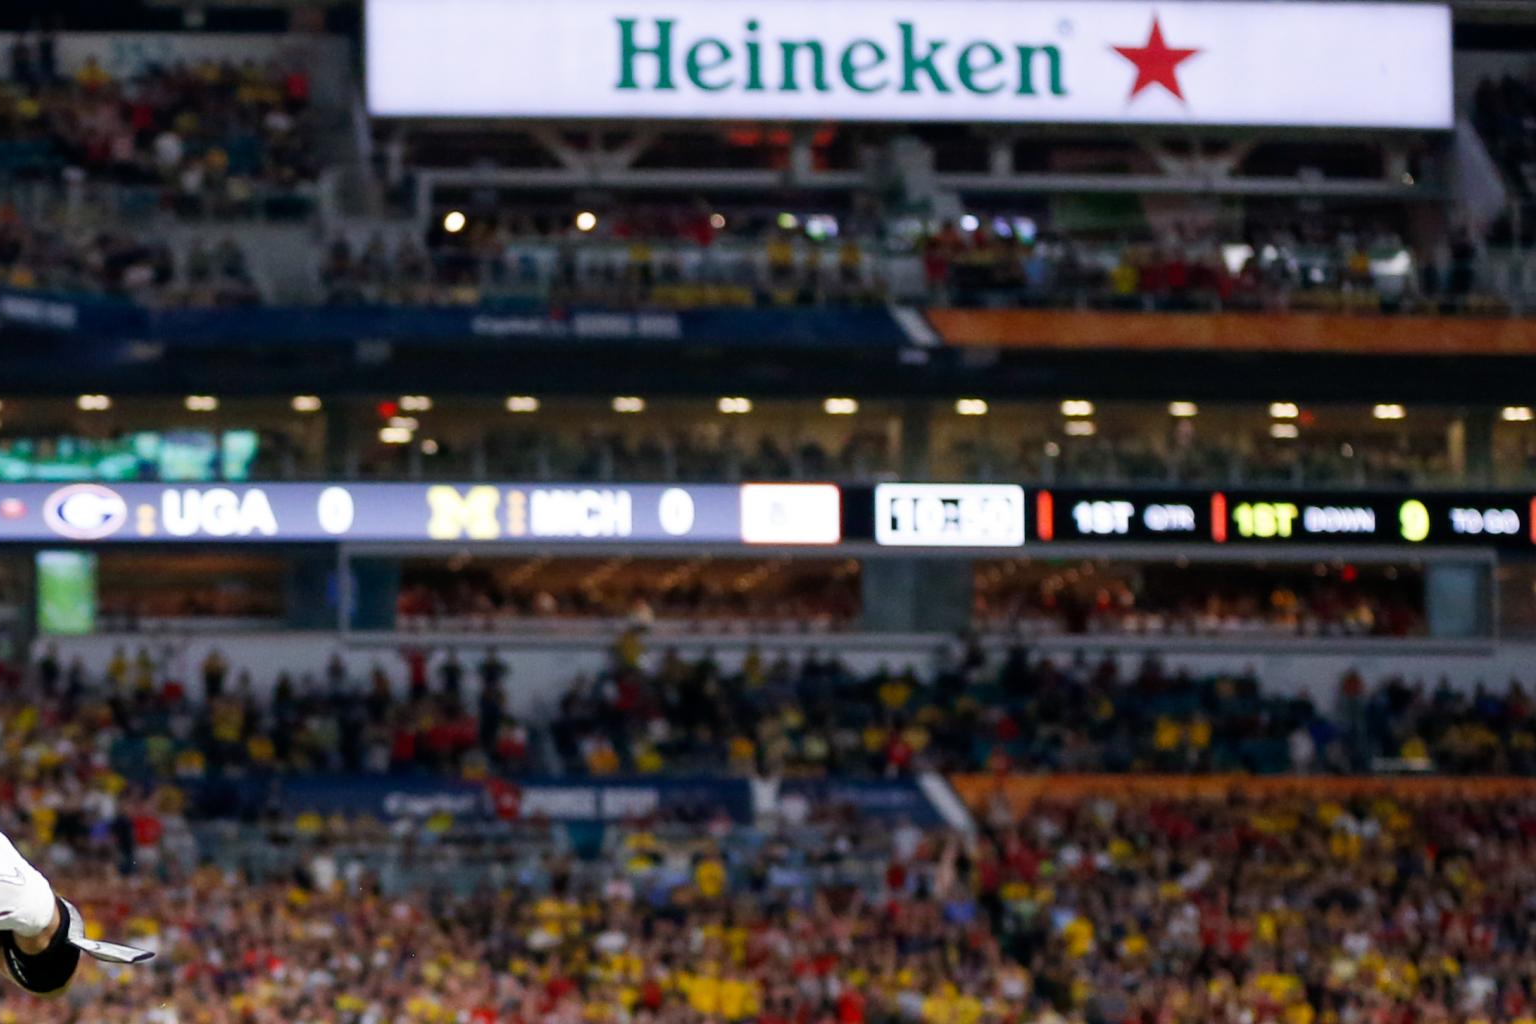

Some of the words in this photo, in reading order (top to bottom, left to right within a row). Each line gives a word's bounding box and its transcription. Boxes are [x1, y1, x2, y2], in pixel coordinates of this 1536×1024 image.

[615, 18, 1069, 97] Heineken
[162, 488, 278, 536] UGA
[317, 487, 354, 534] 0
[427, 485, 500, 540] M
[659, 488, 694, 536] 0
[1072, 501, 1134, 534] 1ST
[1233, 502, 1298, 537] 1ST
